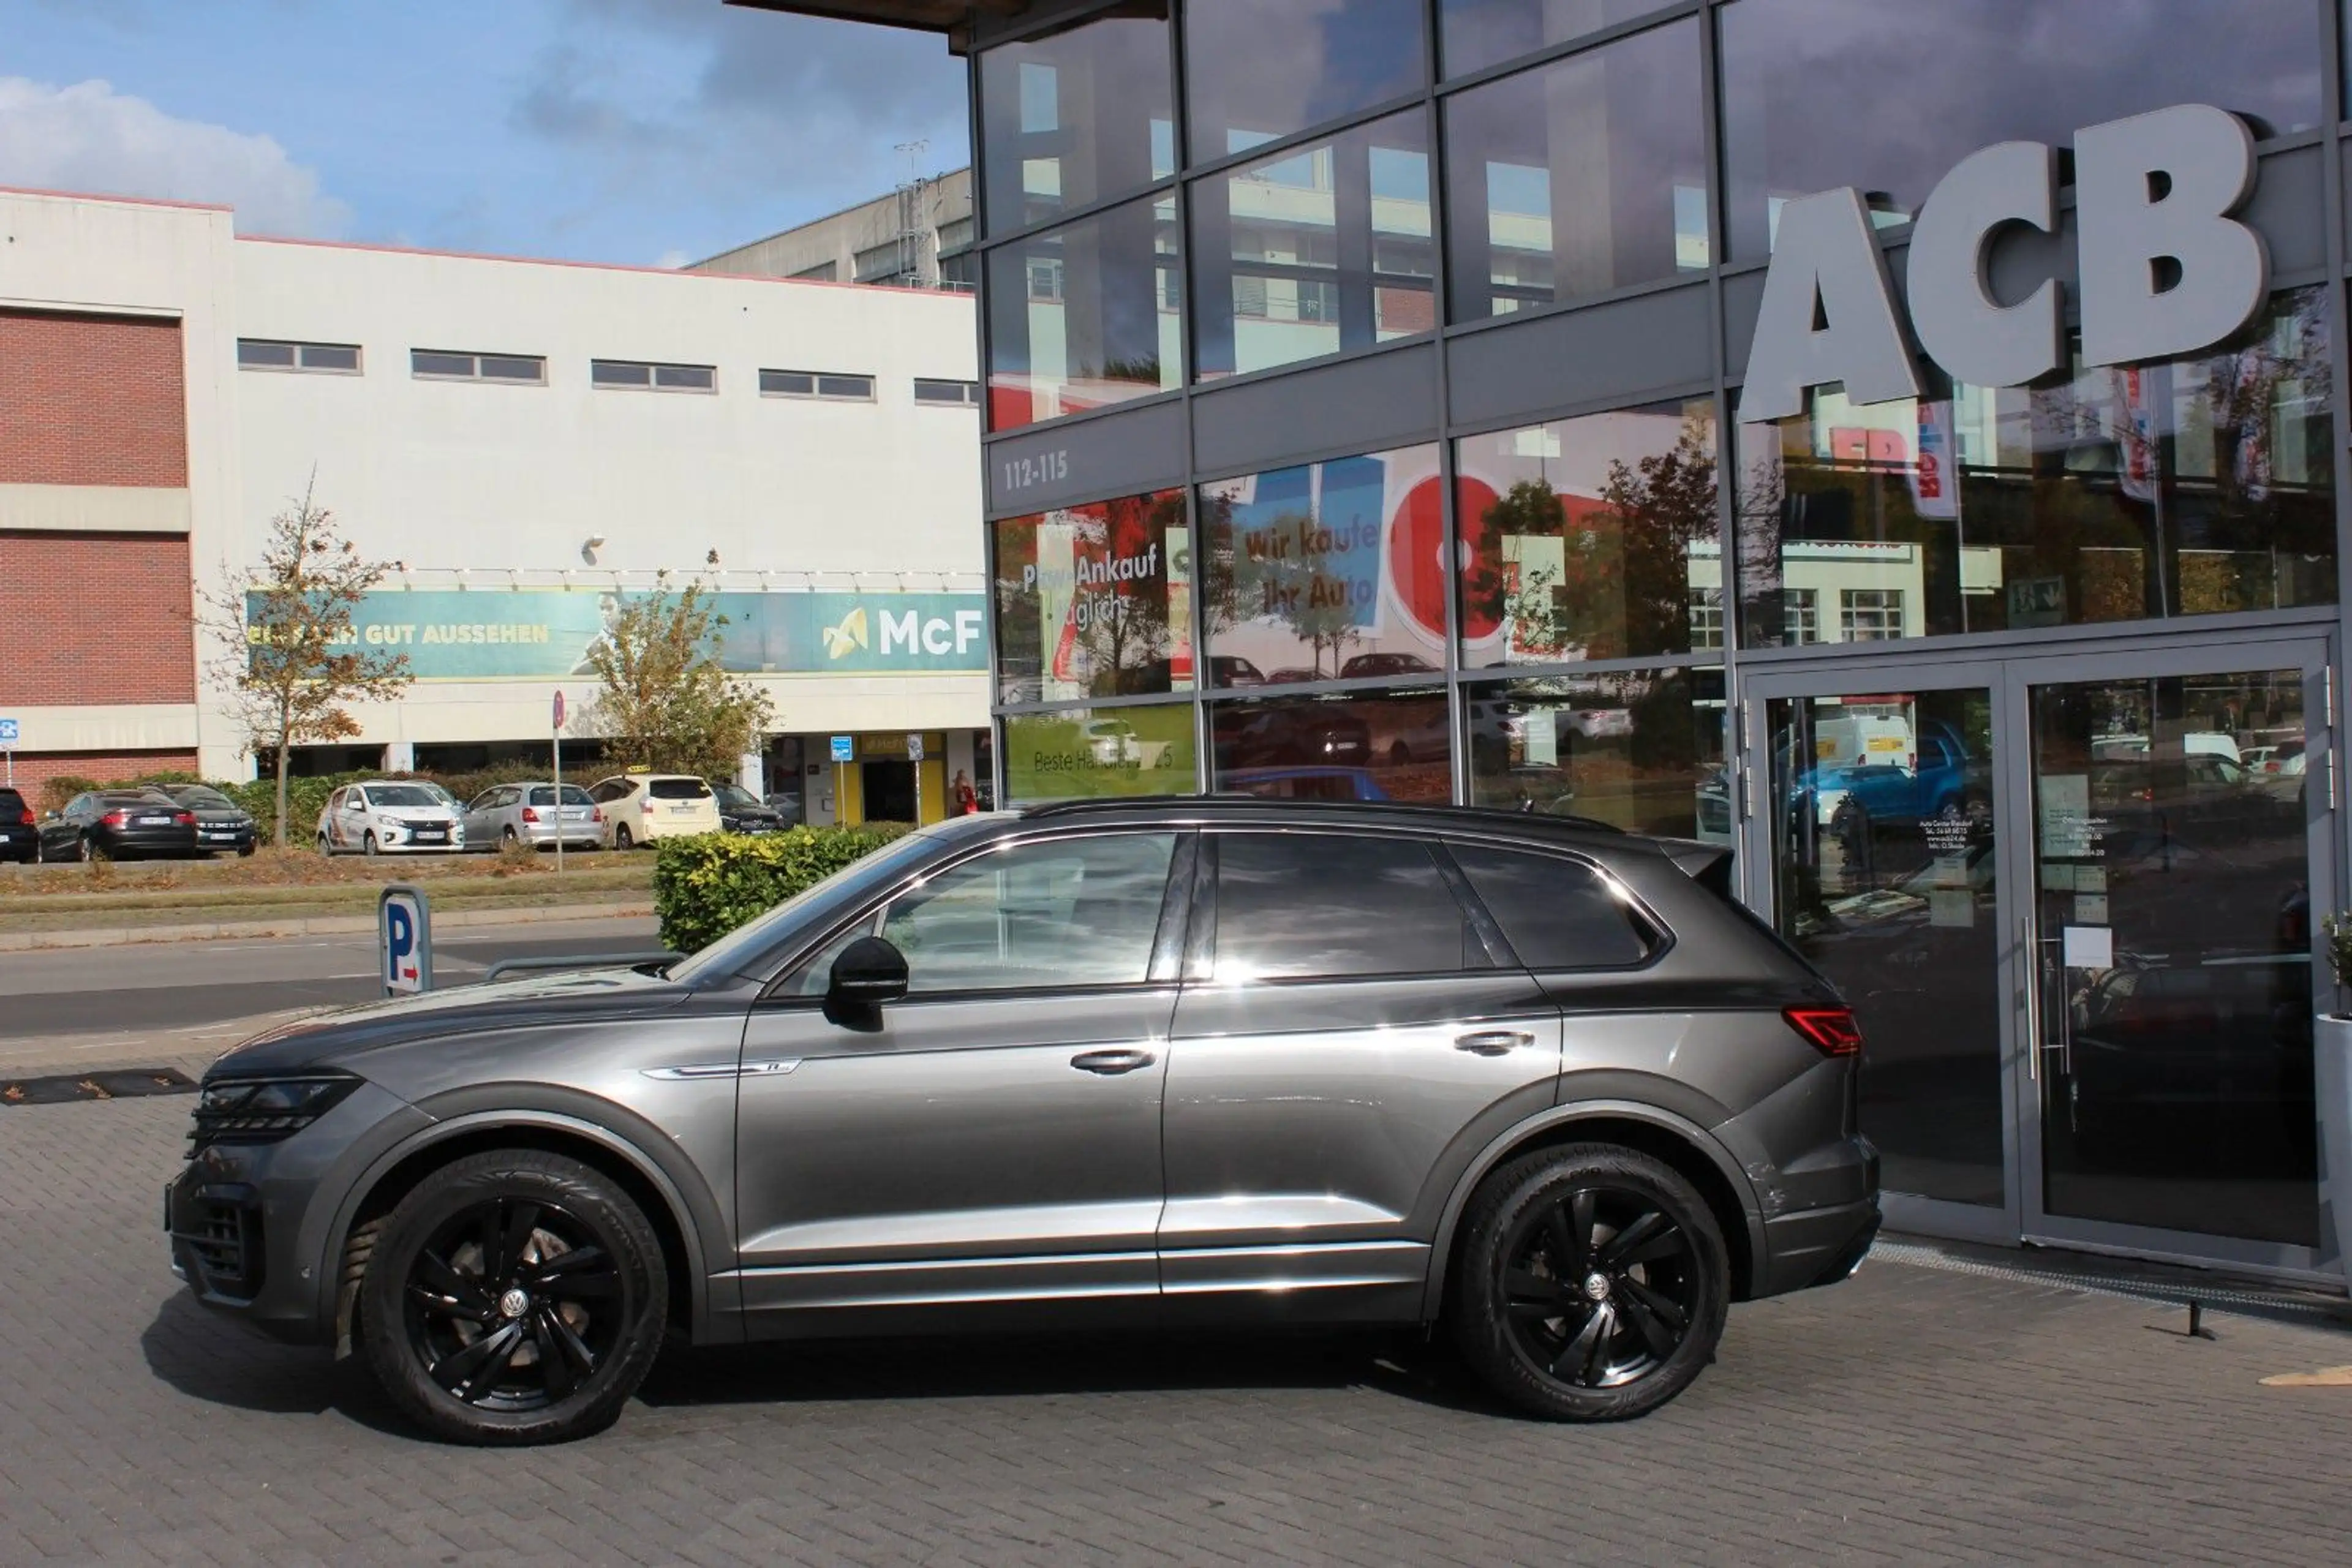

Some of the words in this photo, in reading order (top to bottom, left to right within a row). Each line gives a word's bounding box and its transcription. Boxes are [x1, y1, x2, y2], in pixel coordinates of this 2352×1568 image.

[1737, 104, 2271, 424] ACB
[1005, 450, 1068, 490] 112-115
[1308, 573, 1373, 609] Auto
[366, 625, 415, 644] GUT
[421, 625, 549, 644] AUSSEHEN
[1035, 751, 1072, 772] Beste
[388, 903, 413, 982] P
